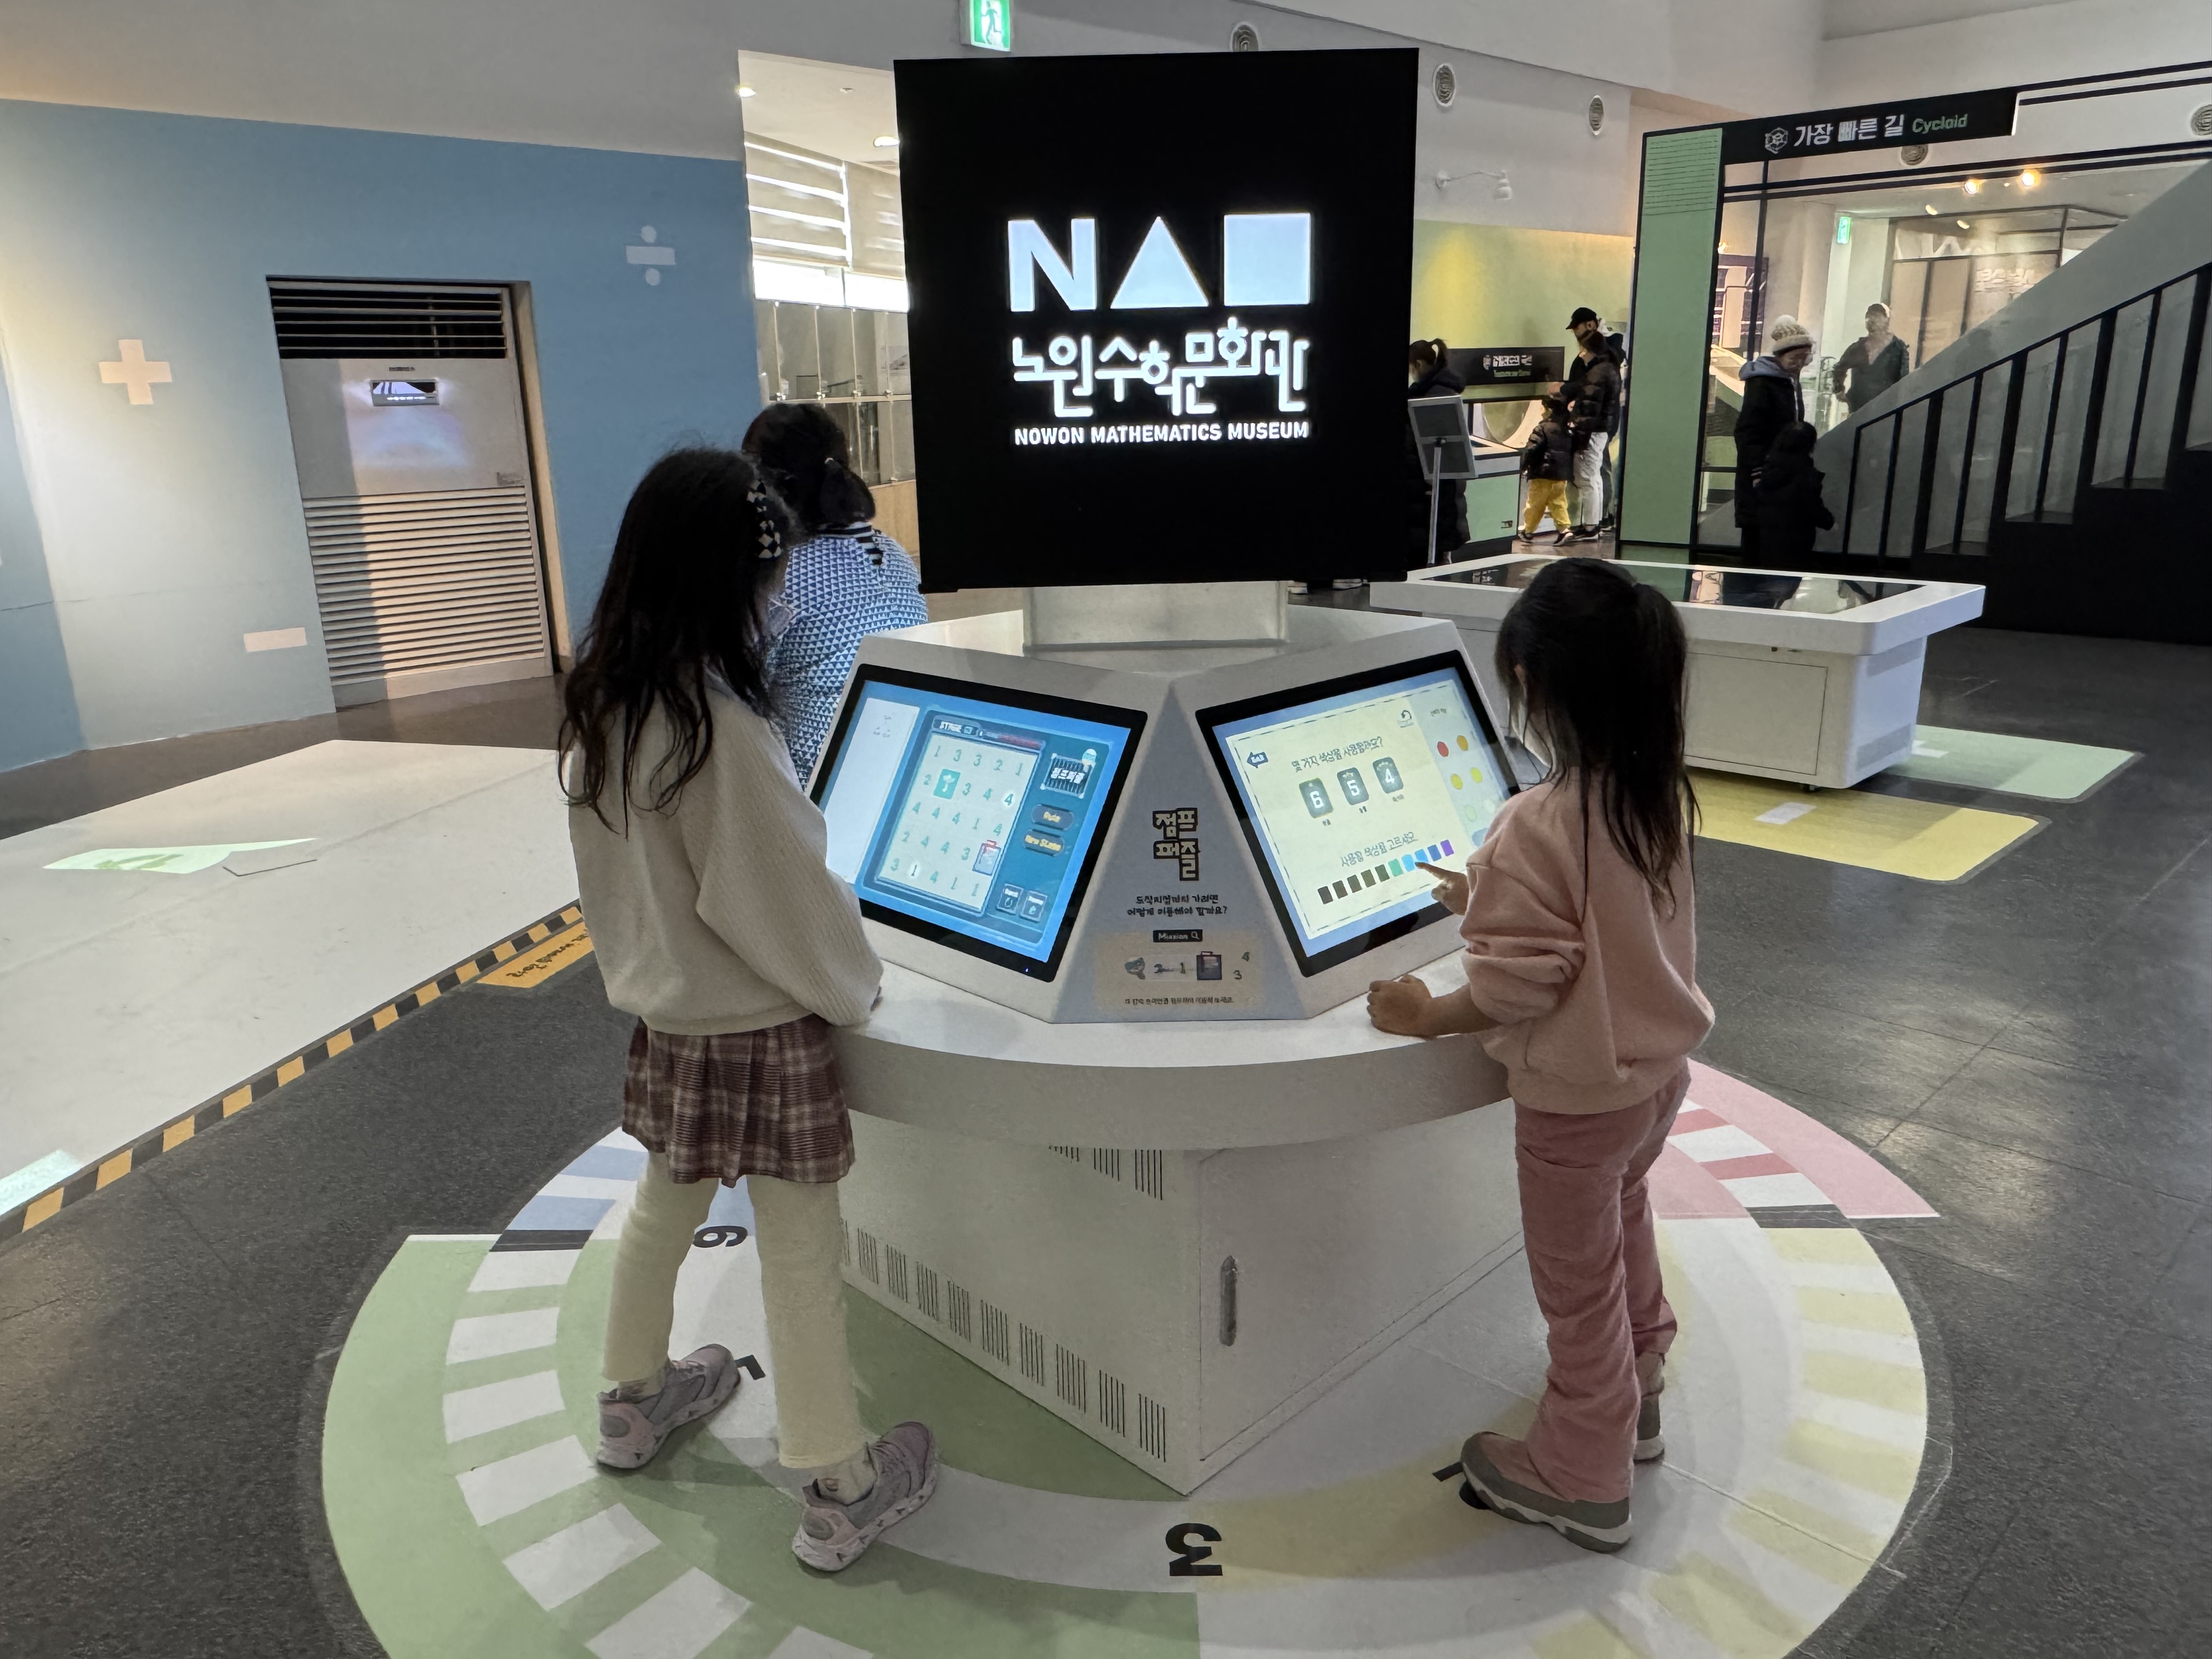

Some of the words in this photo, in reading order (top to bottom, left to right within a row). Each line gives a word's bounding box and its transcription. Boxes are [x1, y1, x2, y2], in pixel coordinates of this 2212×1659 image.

[1793, 123, 1833, 146] 가장
[1838, 117, 1878, 142] 빠른
[1884, 114, 1905, 137] 길
[1912, 114, 1968, 135] Cycloid
[1014, 426, 1085, 446] NOWON
[1091, 422, 1222, 444] MATHEMATICS
[1228, 421, 1310, 441] MUSEUM
[952, 749, 962, 762] 3
[973, 754, 982, 768] 3
[993, 759, 1004, 772] 2
[1301, 755, 1320, 768] 가지
[1385, 768, 1395, 784] 4
[962, 782, 972, 796] 3
[1004, 793, 1014, 806] 4
[1347, 779, 1360, 797] 5
[1310, 791, 1324, 809] 6
[1154, 810, 1195, 838] 점프
[910, 864, 918, 877] 1
[1155, 840, 1197, 879] 퍼즐
